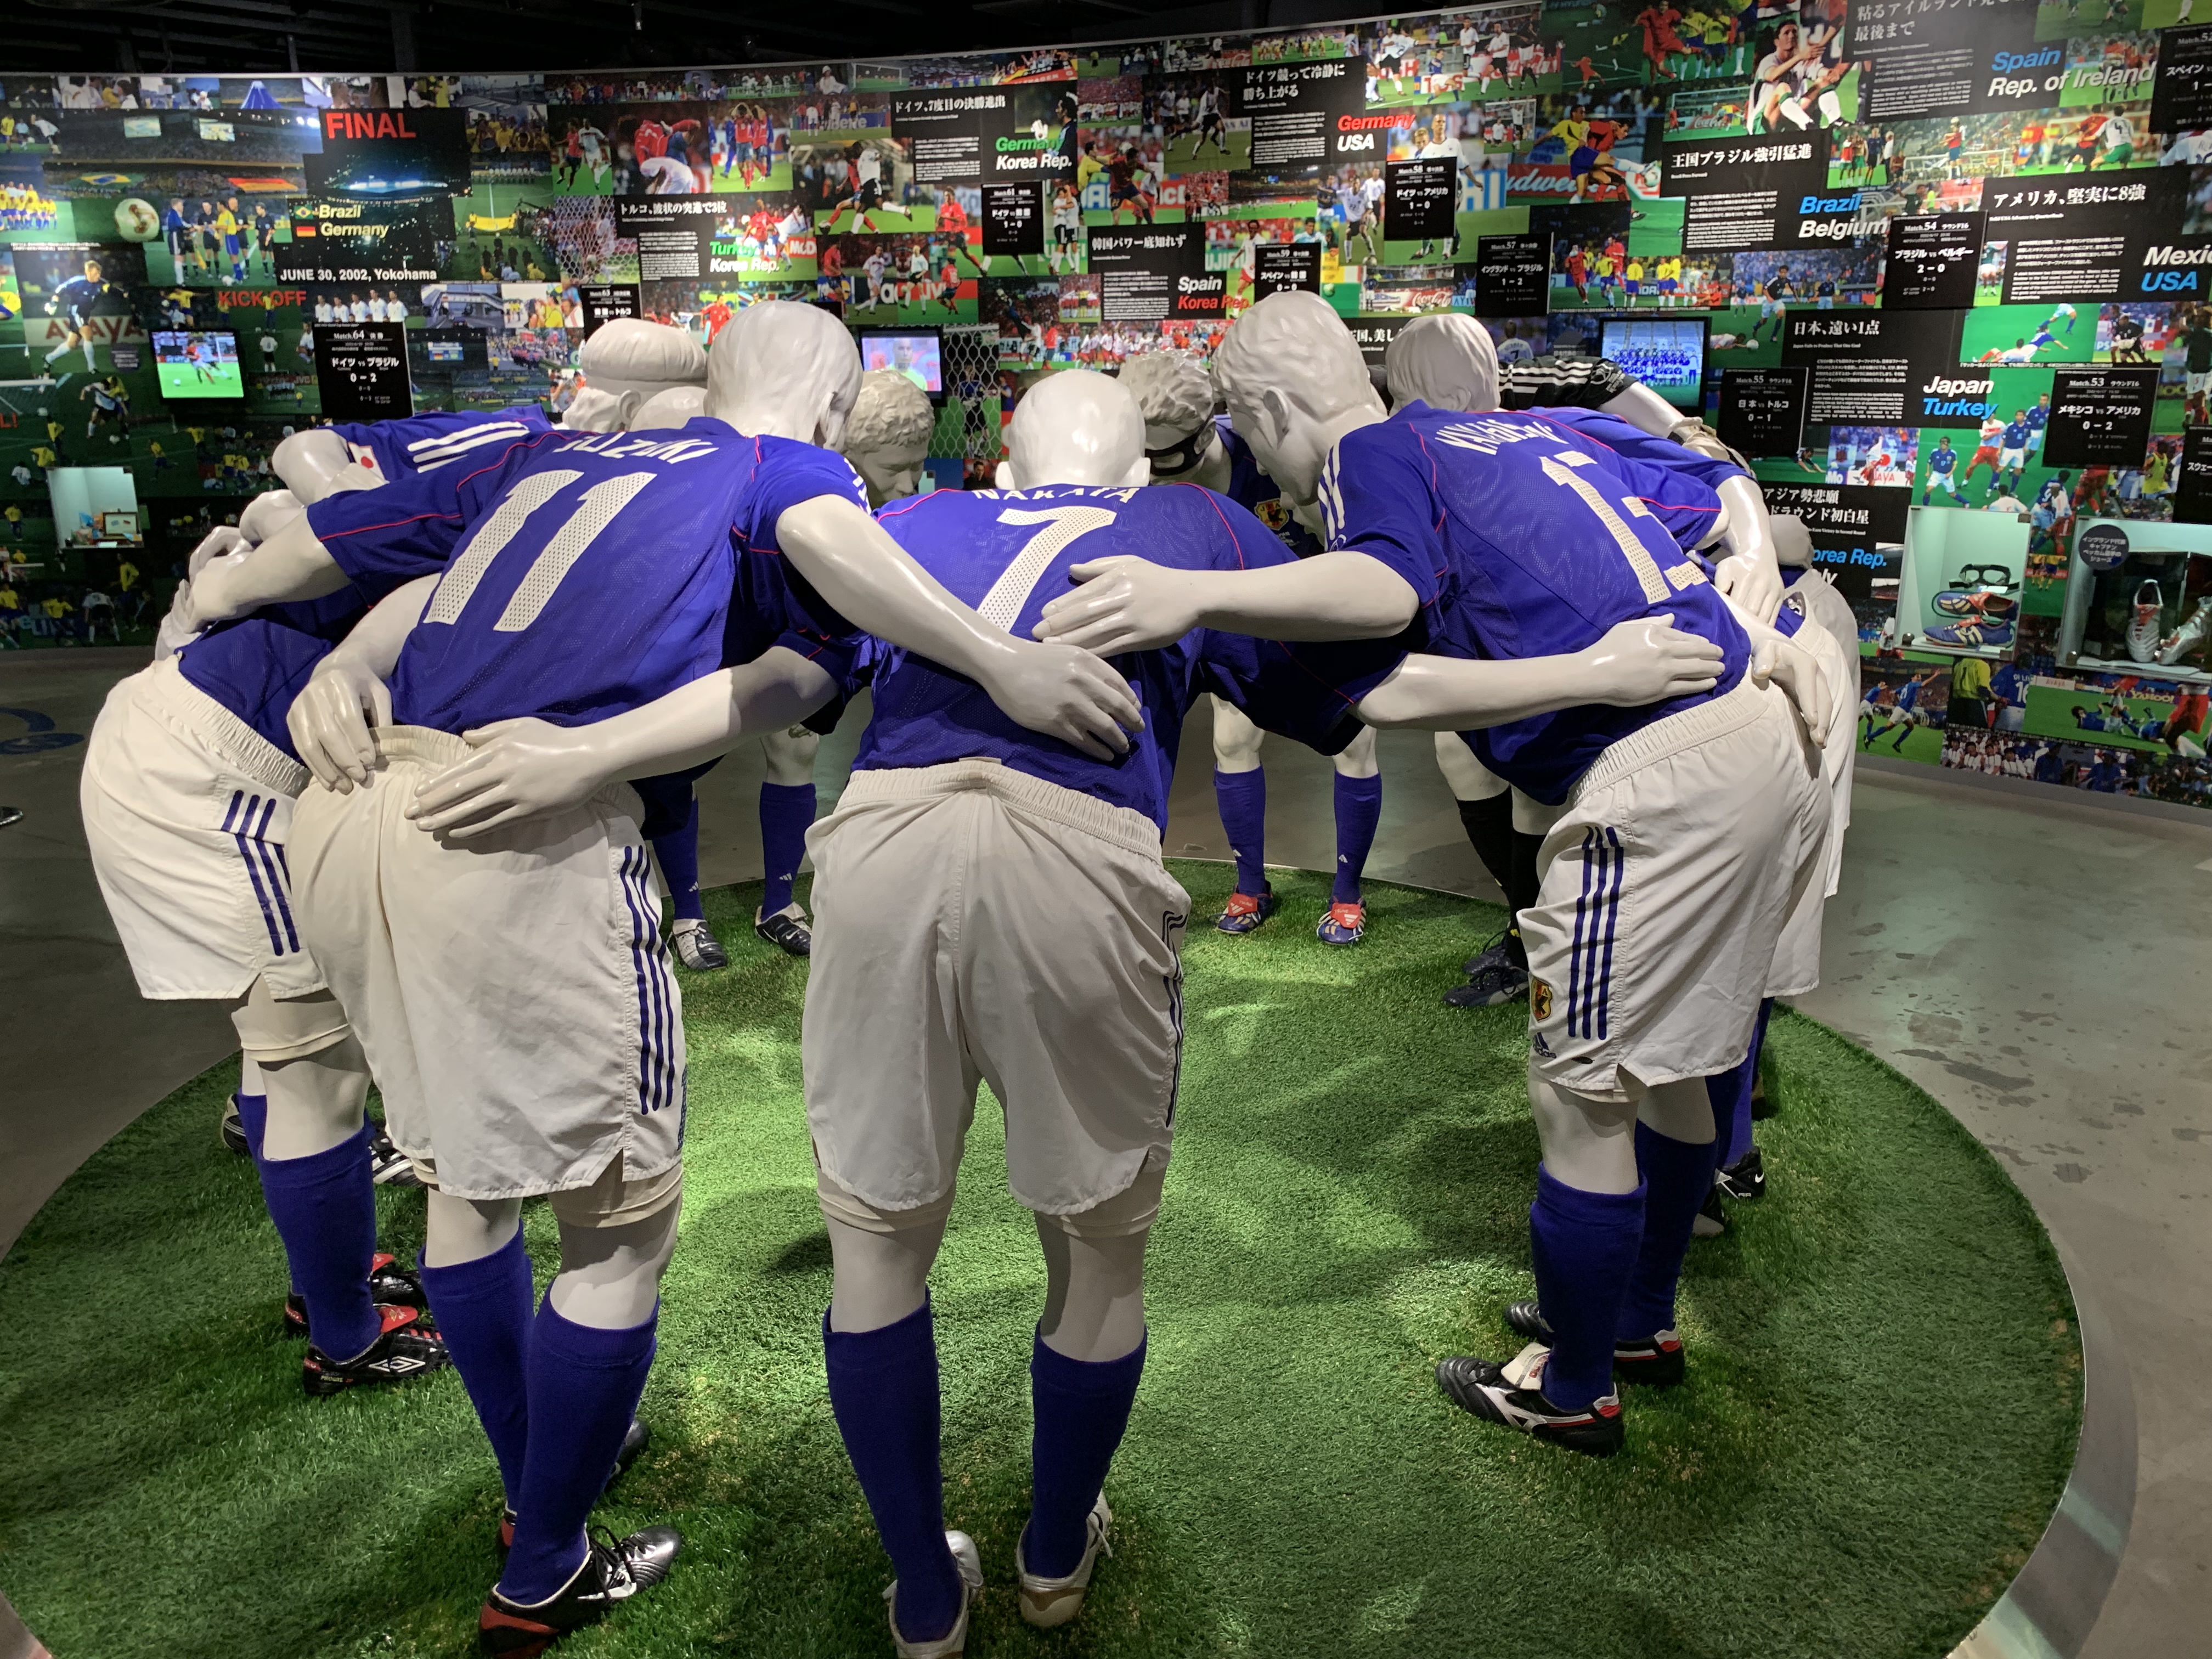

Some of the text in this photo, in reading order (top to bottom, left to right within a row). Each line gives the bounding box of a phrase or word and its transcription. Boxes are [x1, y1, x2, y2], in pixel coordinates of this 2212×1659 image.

[1854, 21, 1915, 42] 最後まで
[1992, 47, 2061, 74] Spain
[1246, 64, 1345, 83] ドイツ競って冷静に
[2166, 64, 2204, 76] スペイン
[1988, 76, 2038, 98] Rep.
[2044, 72, 2069, 91] of
[2072, 63, 2157, 88] Ireland
[1243, 84, 1299, 101] 勝ち上がる
[326, 112, 416, 138] FINAL
[1338, 114, 1416, 131] Germany
[996, 137, 1065, 152] Germany
[1337, 133, 1374, 151] USA
[996, 153, 1072, 170] Korea Rep.
[1672, 143, 1812, 168] 王国ブラジル強引猛進
[1799, 194, 1863, 215] Brazil
[1994, 184, 2147, 208] アメリカ、堅実に8強
[319, 205, 362, 219] Brazil
[320, 223, 389, 238] Germany
[1798, 219, 1887, 240] Belgium
[710, 241, 758, 256] Turkey
[1092, 234, 1187, 250] 韓国パワー底知れず
[1895, 247, 1974, 259] ブラジル ベルギー
[710, 258, 779, 274] Korea Rep.
[1917, 264, 1924, 273] 2
[1937, 263, 1945, 273] 0
[281, 268, 437, 282] JUNE 30, 2002, Yokohama
[2141, 271, 2197, 291] USA
[1178, 276, 1222, 294] Spain
[219, 291, 307, 307] KICK OFF
[1178, 294, 1251, 312] Korea Rep.
[1794, 319, 1881, 335] 日本、遠い1点
[331, 357, 356, 367] ドイツ
[350, 373, 357, 382] 0
[369, 373, 377, 382] 2
[1923, 376, 1994, 397] Japan
[1768, 400, 1789, 408] トルコ
[1922, 397, 1998, 419] Turkey
[2058, 405, 2094, 414] メキシコ
[2106, 406, 2141, 415] アメリカ
[1767, 414, 1771, 422] 1
[2083, 421, 2090, 430] 0
[2105, 421, 2112, 430] 2
[1764, 487, 1839, 504] アジア勢悲願
[423, 470, 657, 631] 11
[1812, 549, 1887, 569] orea Rep.
[976, 506, 1117, 633] 7
